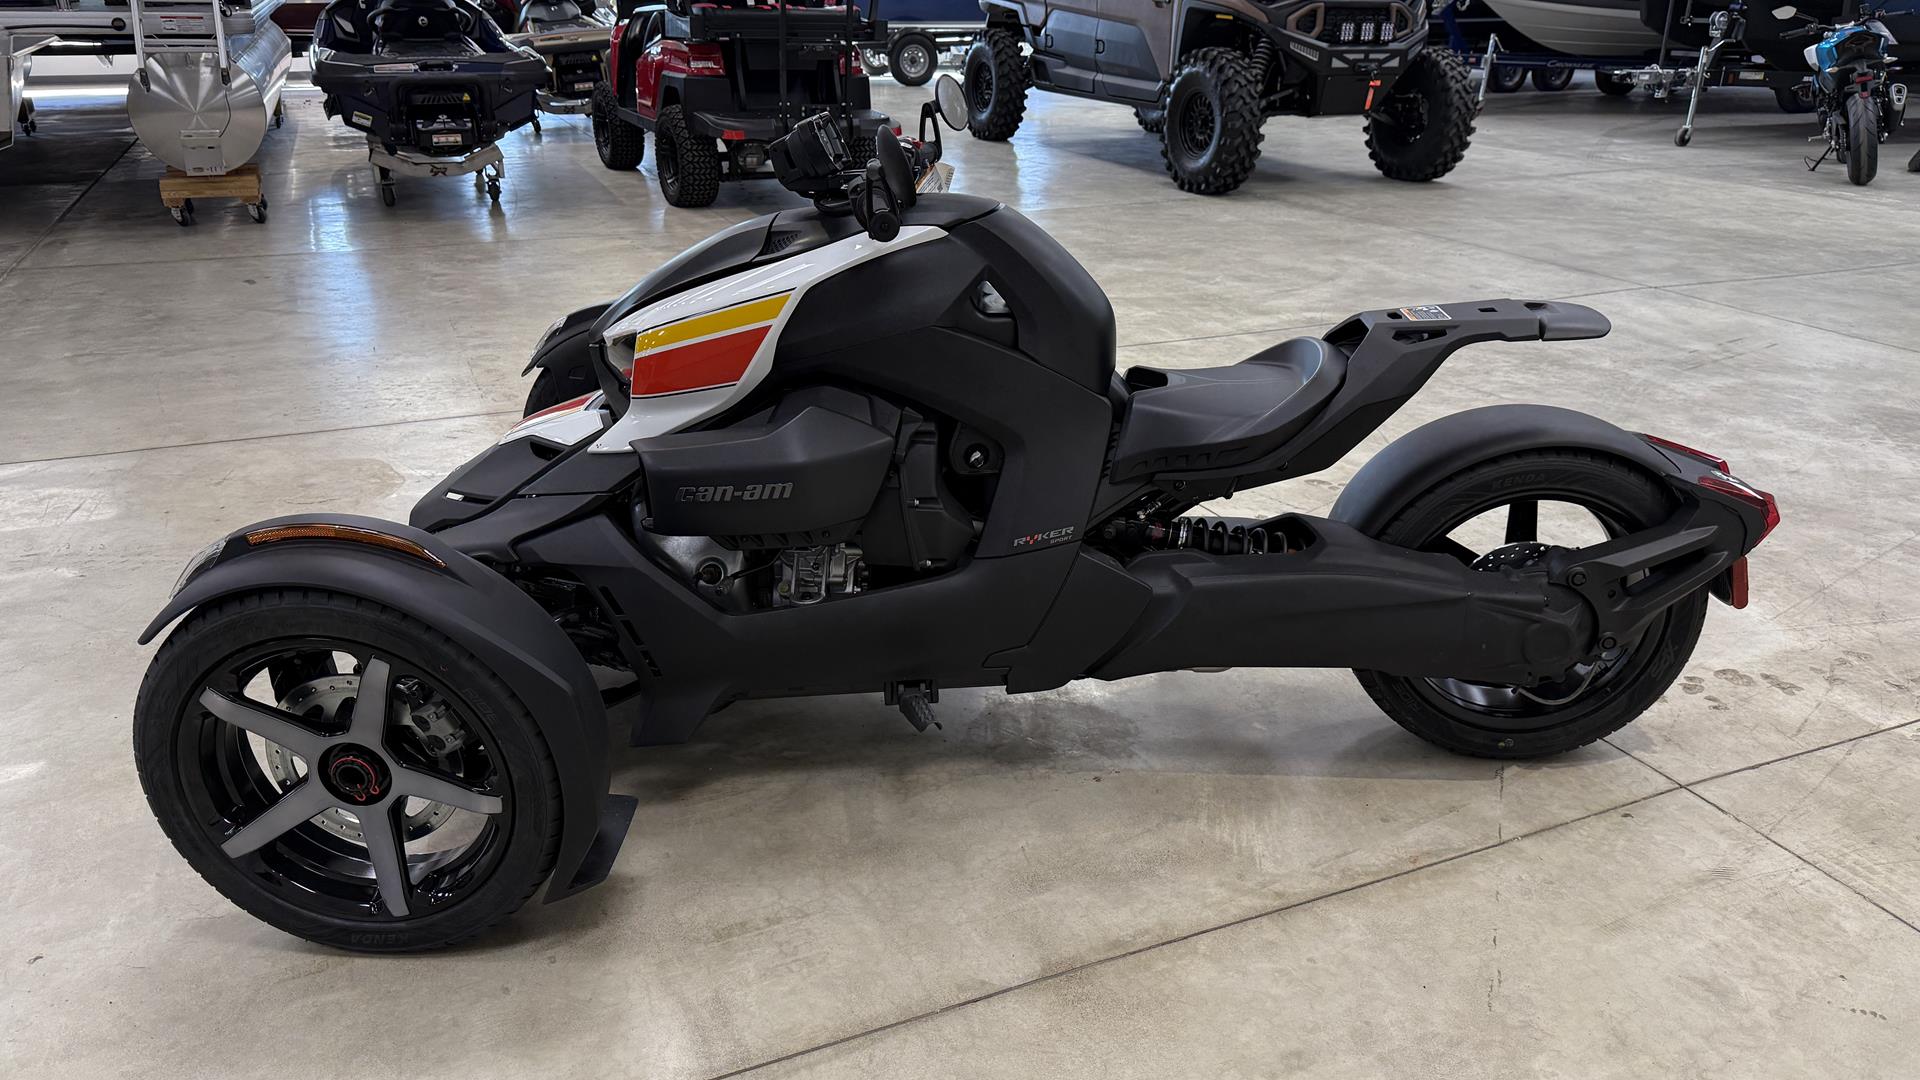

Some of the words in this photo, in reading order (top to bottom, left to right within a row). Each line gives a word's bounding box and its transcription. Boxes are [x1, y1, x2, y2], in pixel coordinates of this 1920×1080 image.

[1491, 472, 1546, 491] KENDA
[1013, 526, 1075, 547] RYKER
[1050, 535, 1073, 545] SPORT
[351, 932, 409, 945] KENDA
